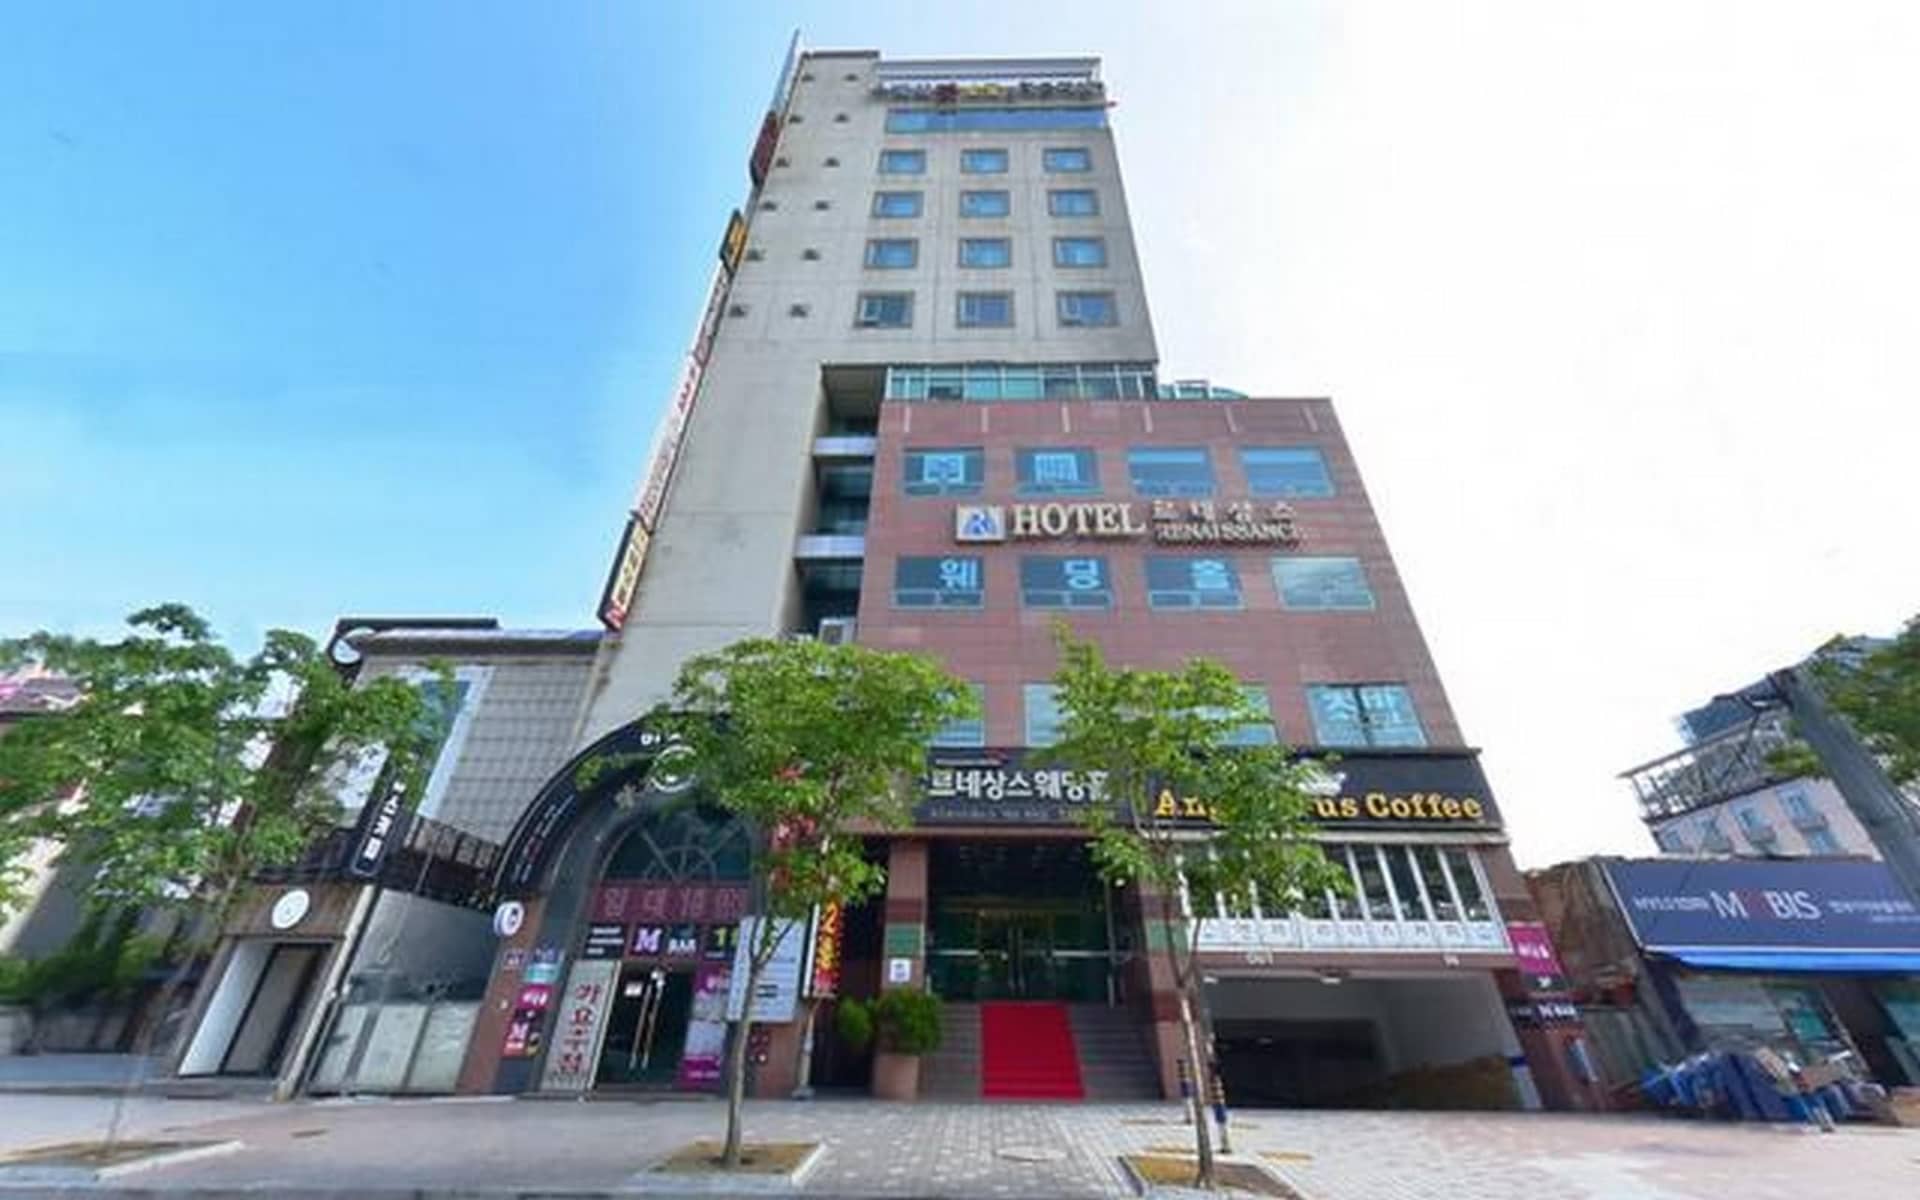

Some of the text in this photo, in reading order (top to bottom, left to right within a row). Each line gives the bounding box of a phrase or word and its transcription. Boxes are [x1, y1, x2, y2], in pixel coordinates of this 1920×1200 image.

[1013, 503, 1146, 536] HOTEL
[1154, 522, 1308, 541] RENAISSANC
[1366, 792, 1483, 819] Coffee
